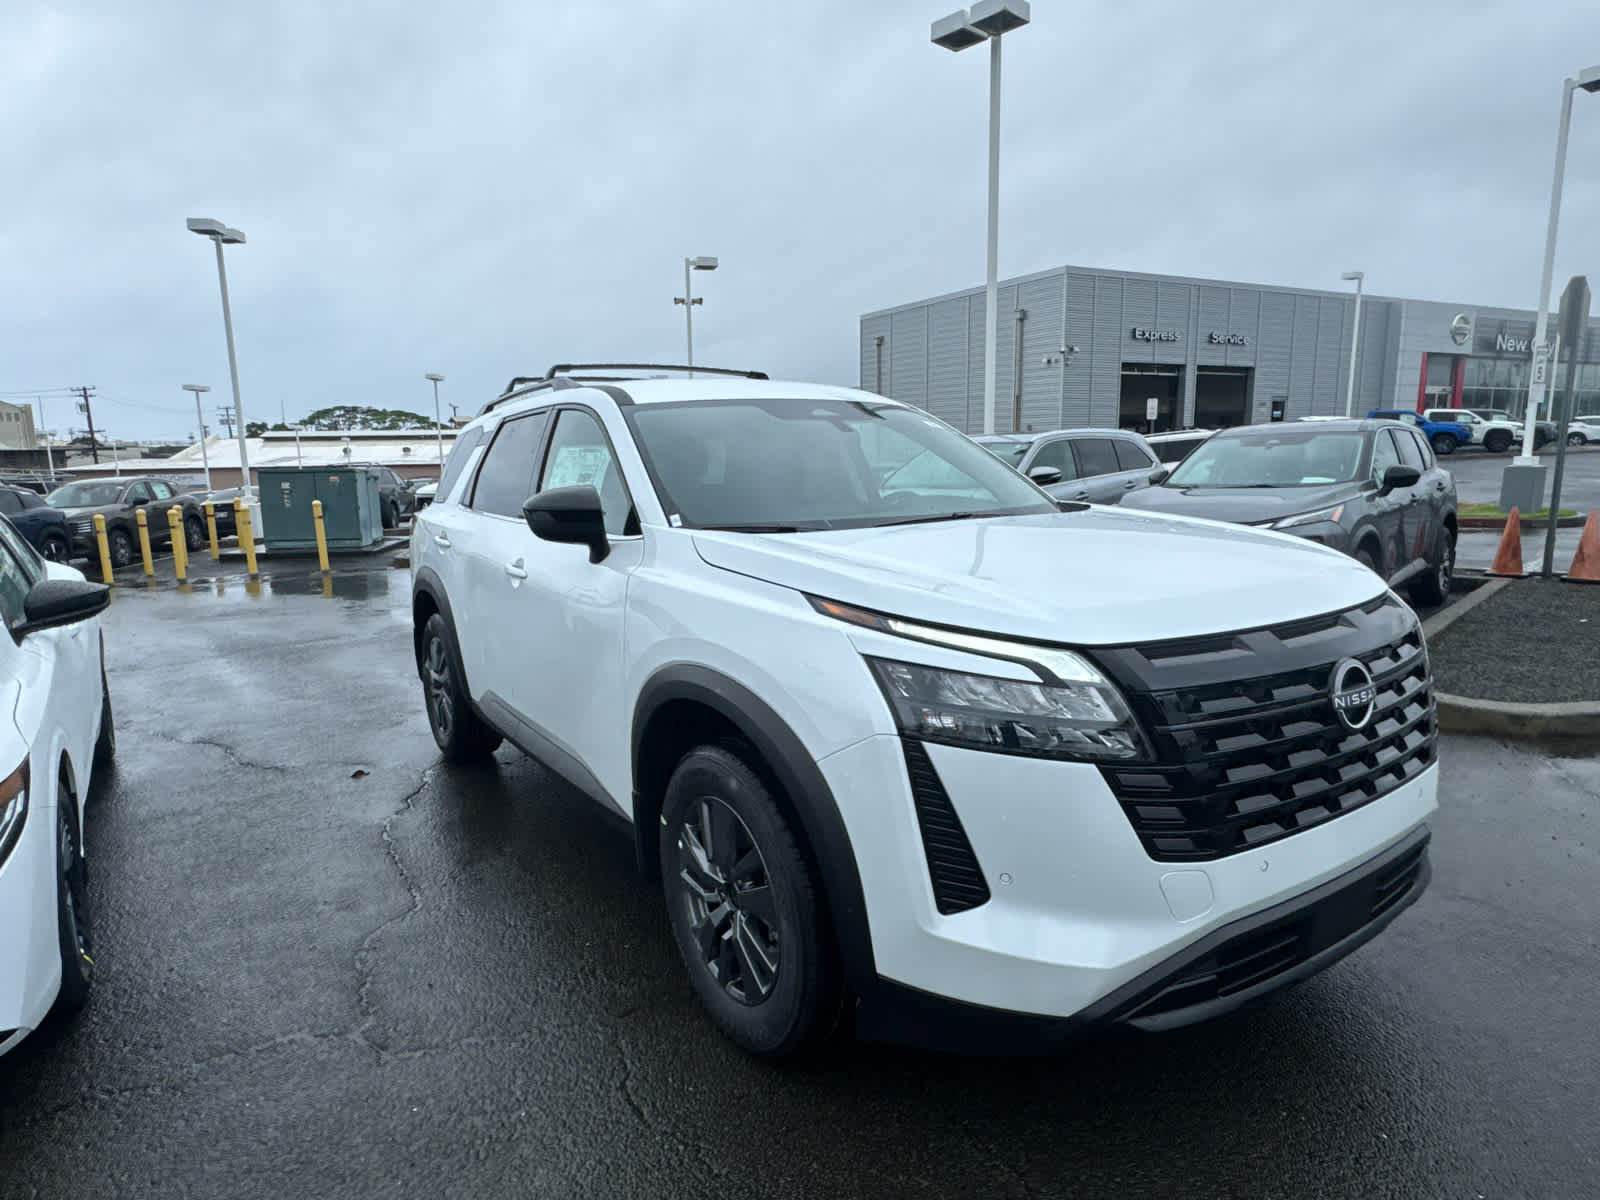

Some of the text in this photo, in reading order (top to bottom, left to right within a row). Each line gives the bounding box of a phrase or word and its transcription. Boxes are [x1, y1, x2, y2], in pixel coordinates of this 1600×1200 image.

[1133, 328, 1249, 346] Express Service
[1496, 334, 1528, 352] New
[1334, 688, 1375, 708] NISSA
